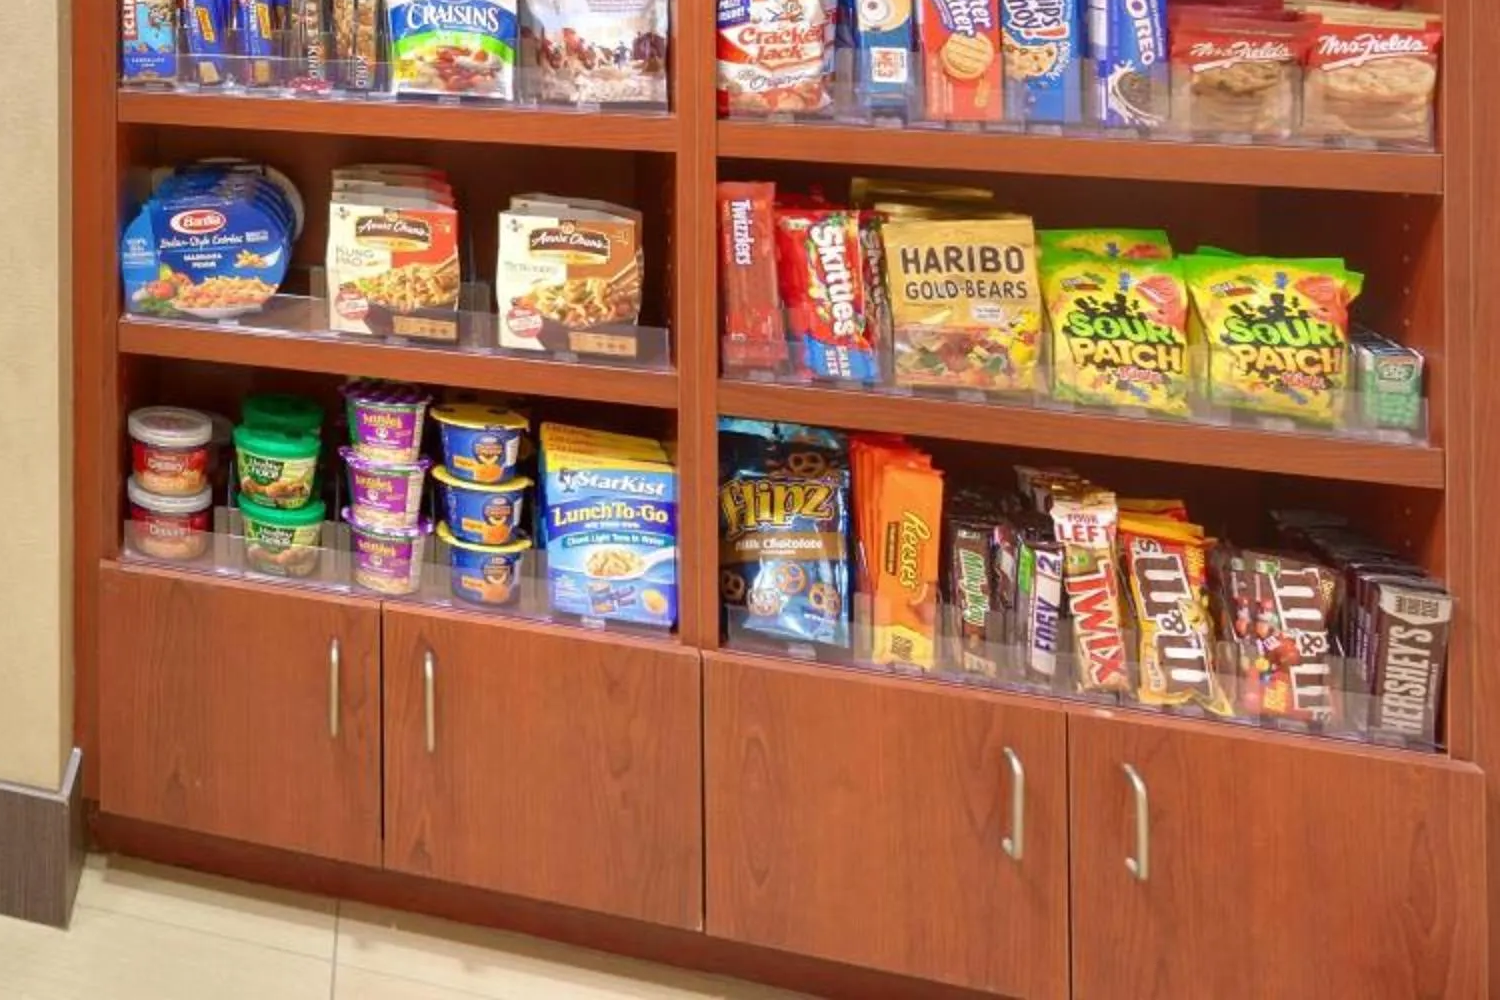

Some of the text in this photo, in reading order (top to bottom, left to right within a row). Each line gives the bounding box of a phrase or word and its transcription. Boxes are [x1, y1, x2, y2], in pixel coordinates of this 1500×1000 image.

[407, 1, 499, 31] CRAISINS
[901, 246, 1026, 275] HARIBO
[810, 224, 856, 337] Skittles
[1067, 311, 1175, 343] SOUR
[1224, 317, 1336, 348] SOUR
[1072, 338, 1183, 373] PATCH
[1237, 346, 1342, 375] PATCH
[578, 471, 666, 496] StarKist
[1066, 557, 1127, 684] TWIX
[1381, 625, 1434, 735] HERSHEY'S
